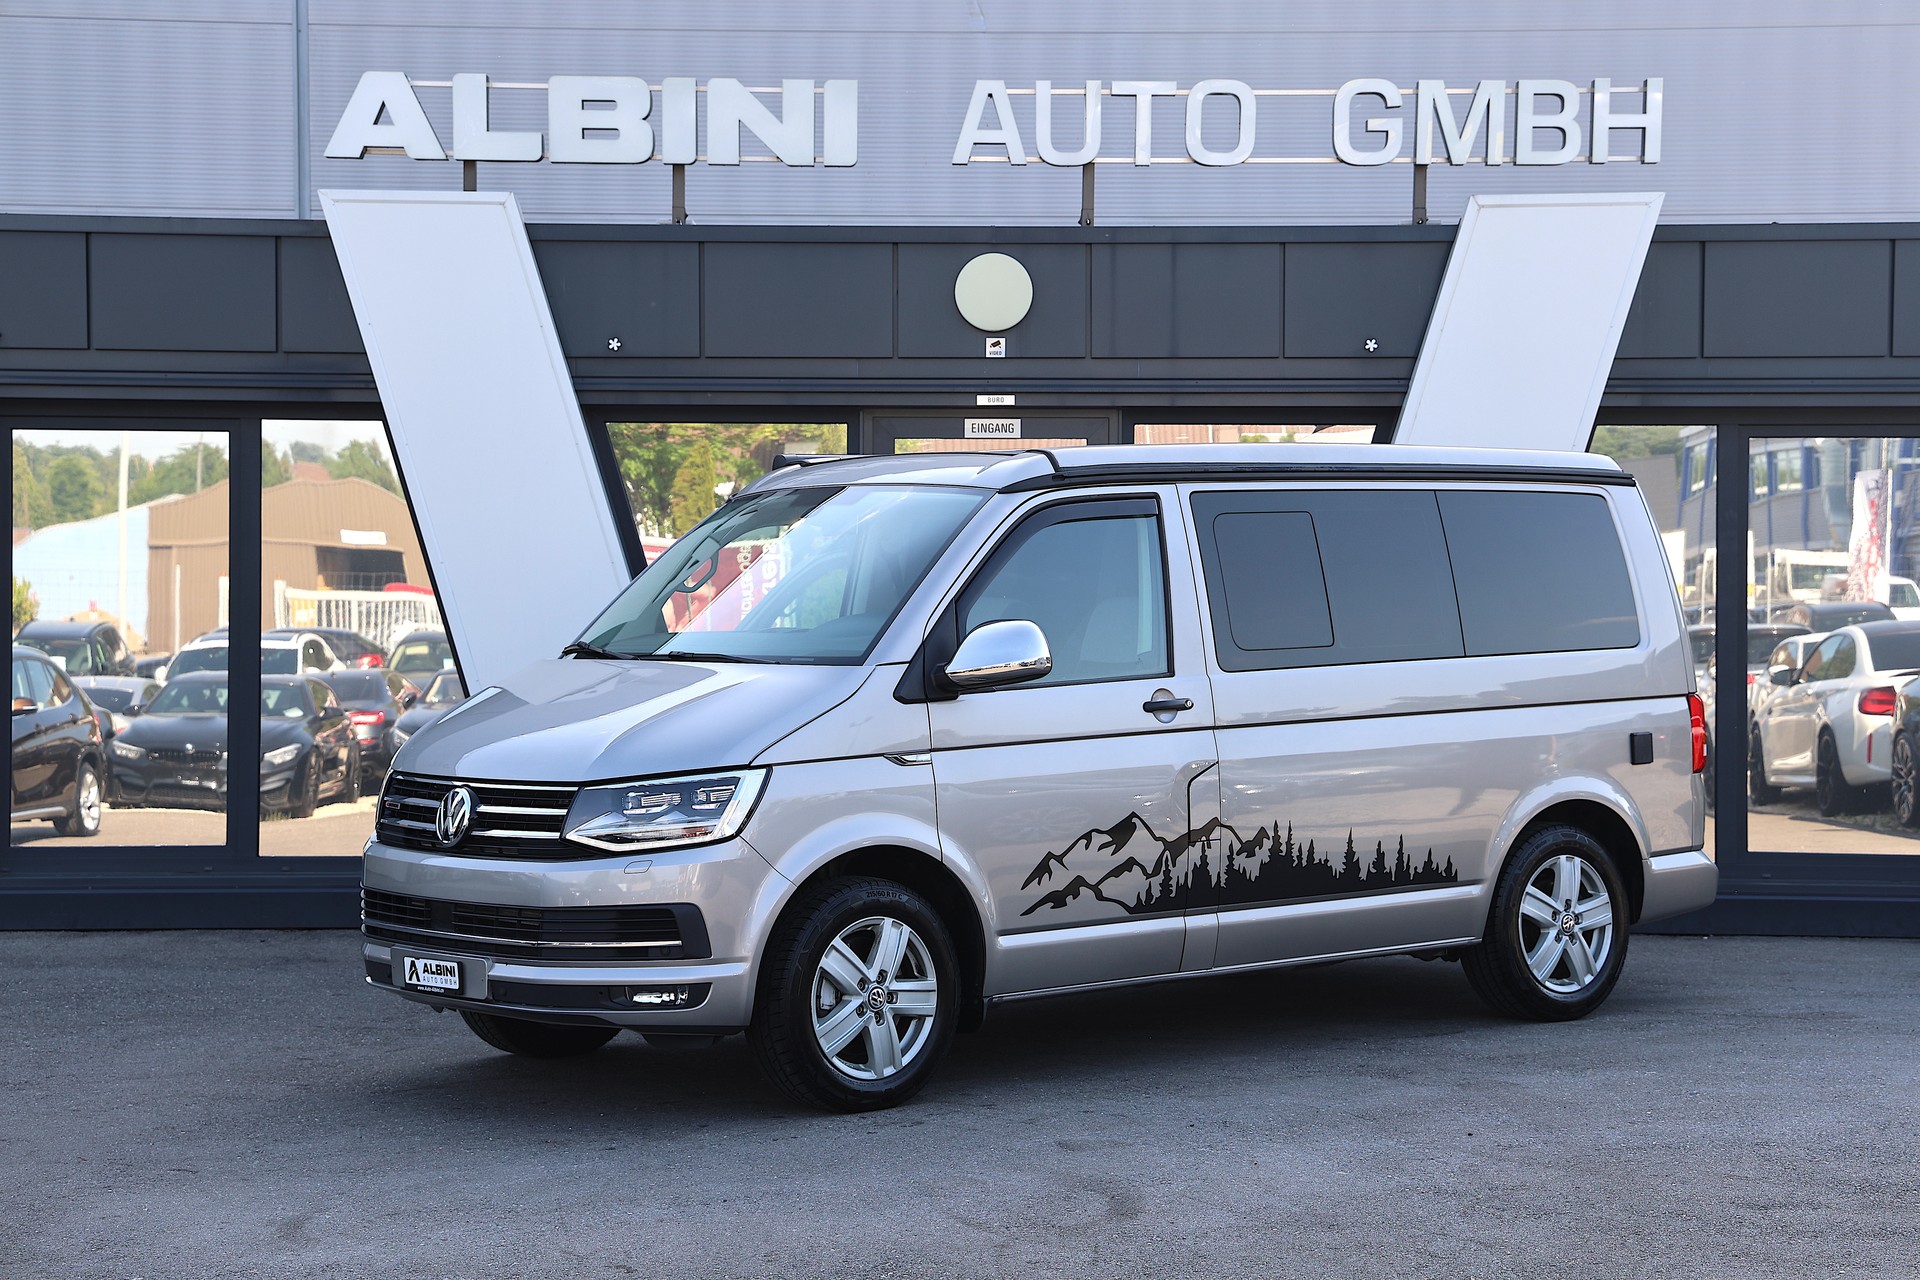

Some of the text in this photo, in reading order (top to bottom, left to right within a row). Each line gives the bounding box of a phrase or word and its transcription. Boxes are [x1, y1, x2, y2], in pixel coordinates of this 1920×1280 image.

[323, 70, 1663, 167] ALBINI AUTO GMBH
[971, 422, 1015, 433] EINGANG
[422, 962, 456, 978] ALBINI
[423, 975, 457, 986] AUTO GMBH
